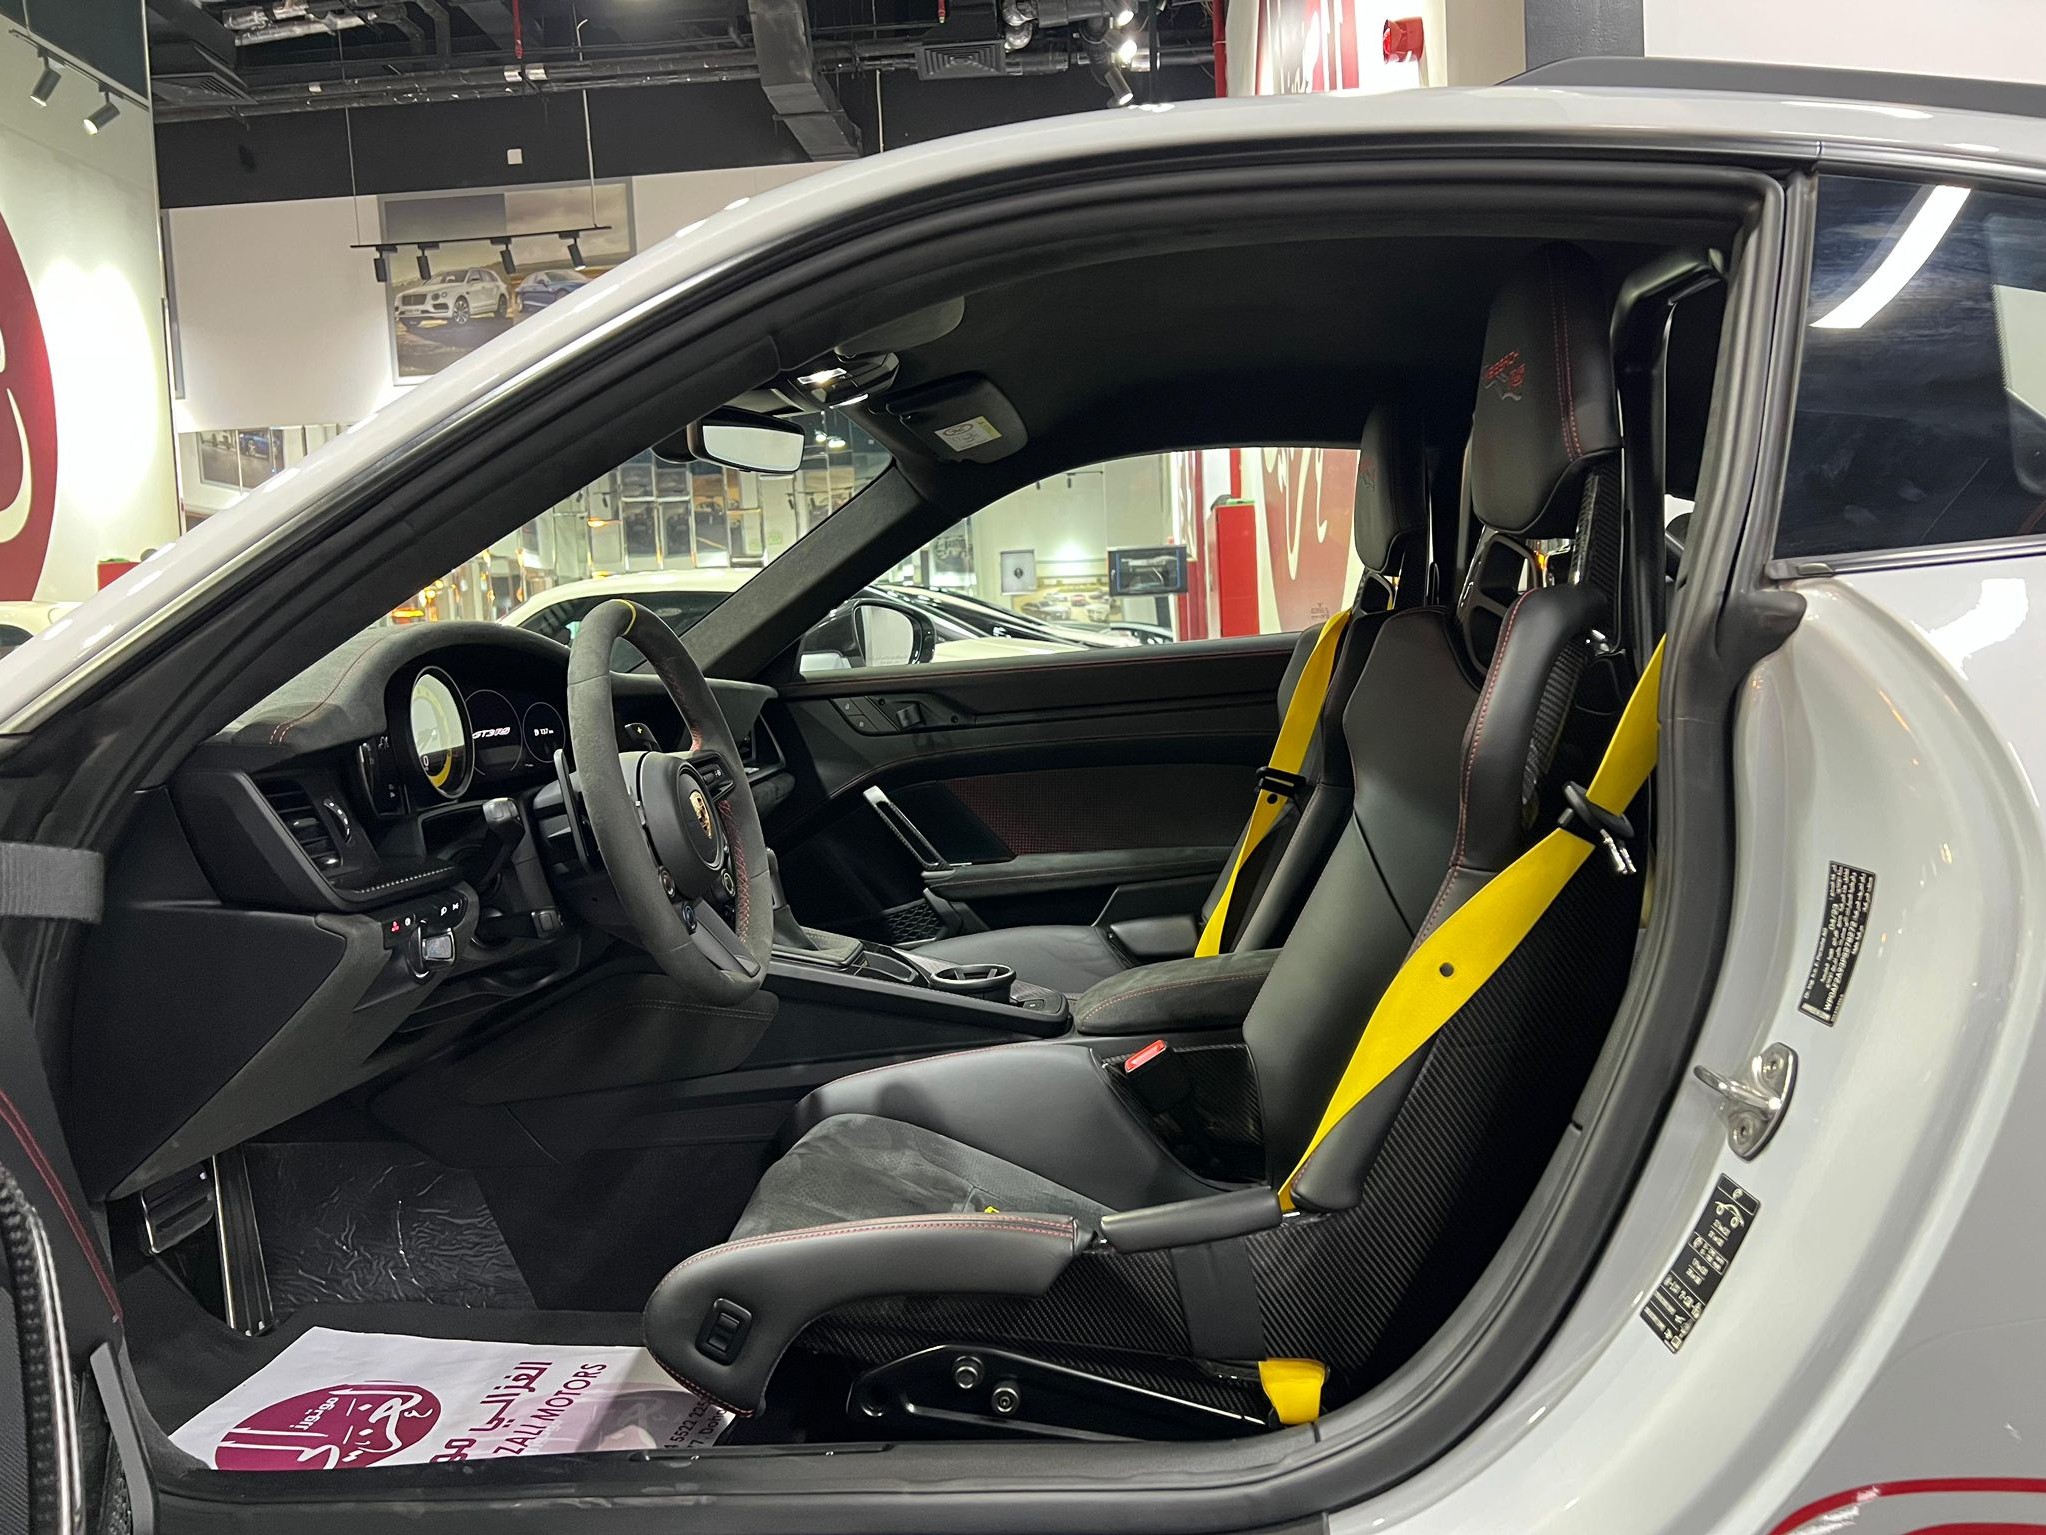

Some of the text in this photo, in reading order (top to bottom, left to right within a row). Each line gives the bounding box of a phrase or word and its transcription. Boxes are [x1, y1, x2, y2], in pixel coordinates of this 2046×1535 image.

[530, 1363, 607, 1421] MOTORS
[289, 1396, 339, 1430] موتورز
[669, 1420, 697, 1442] 5522
